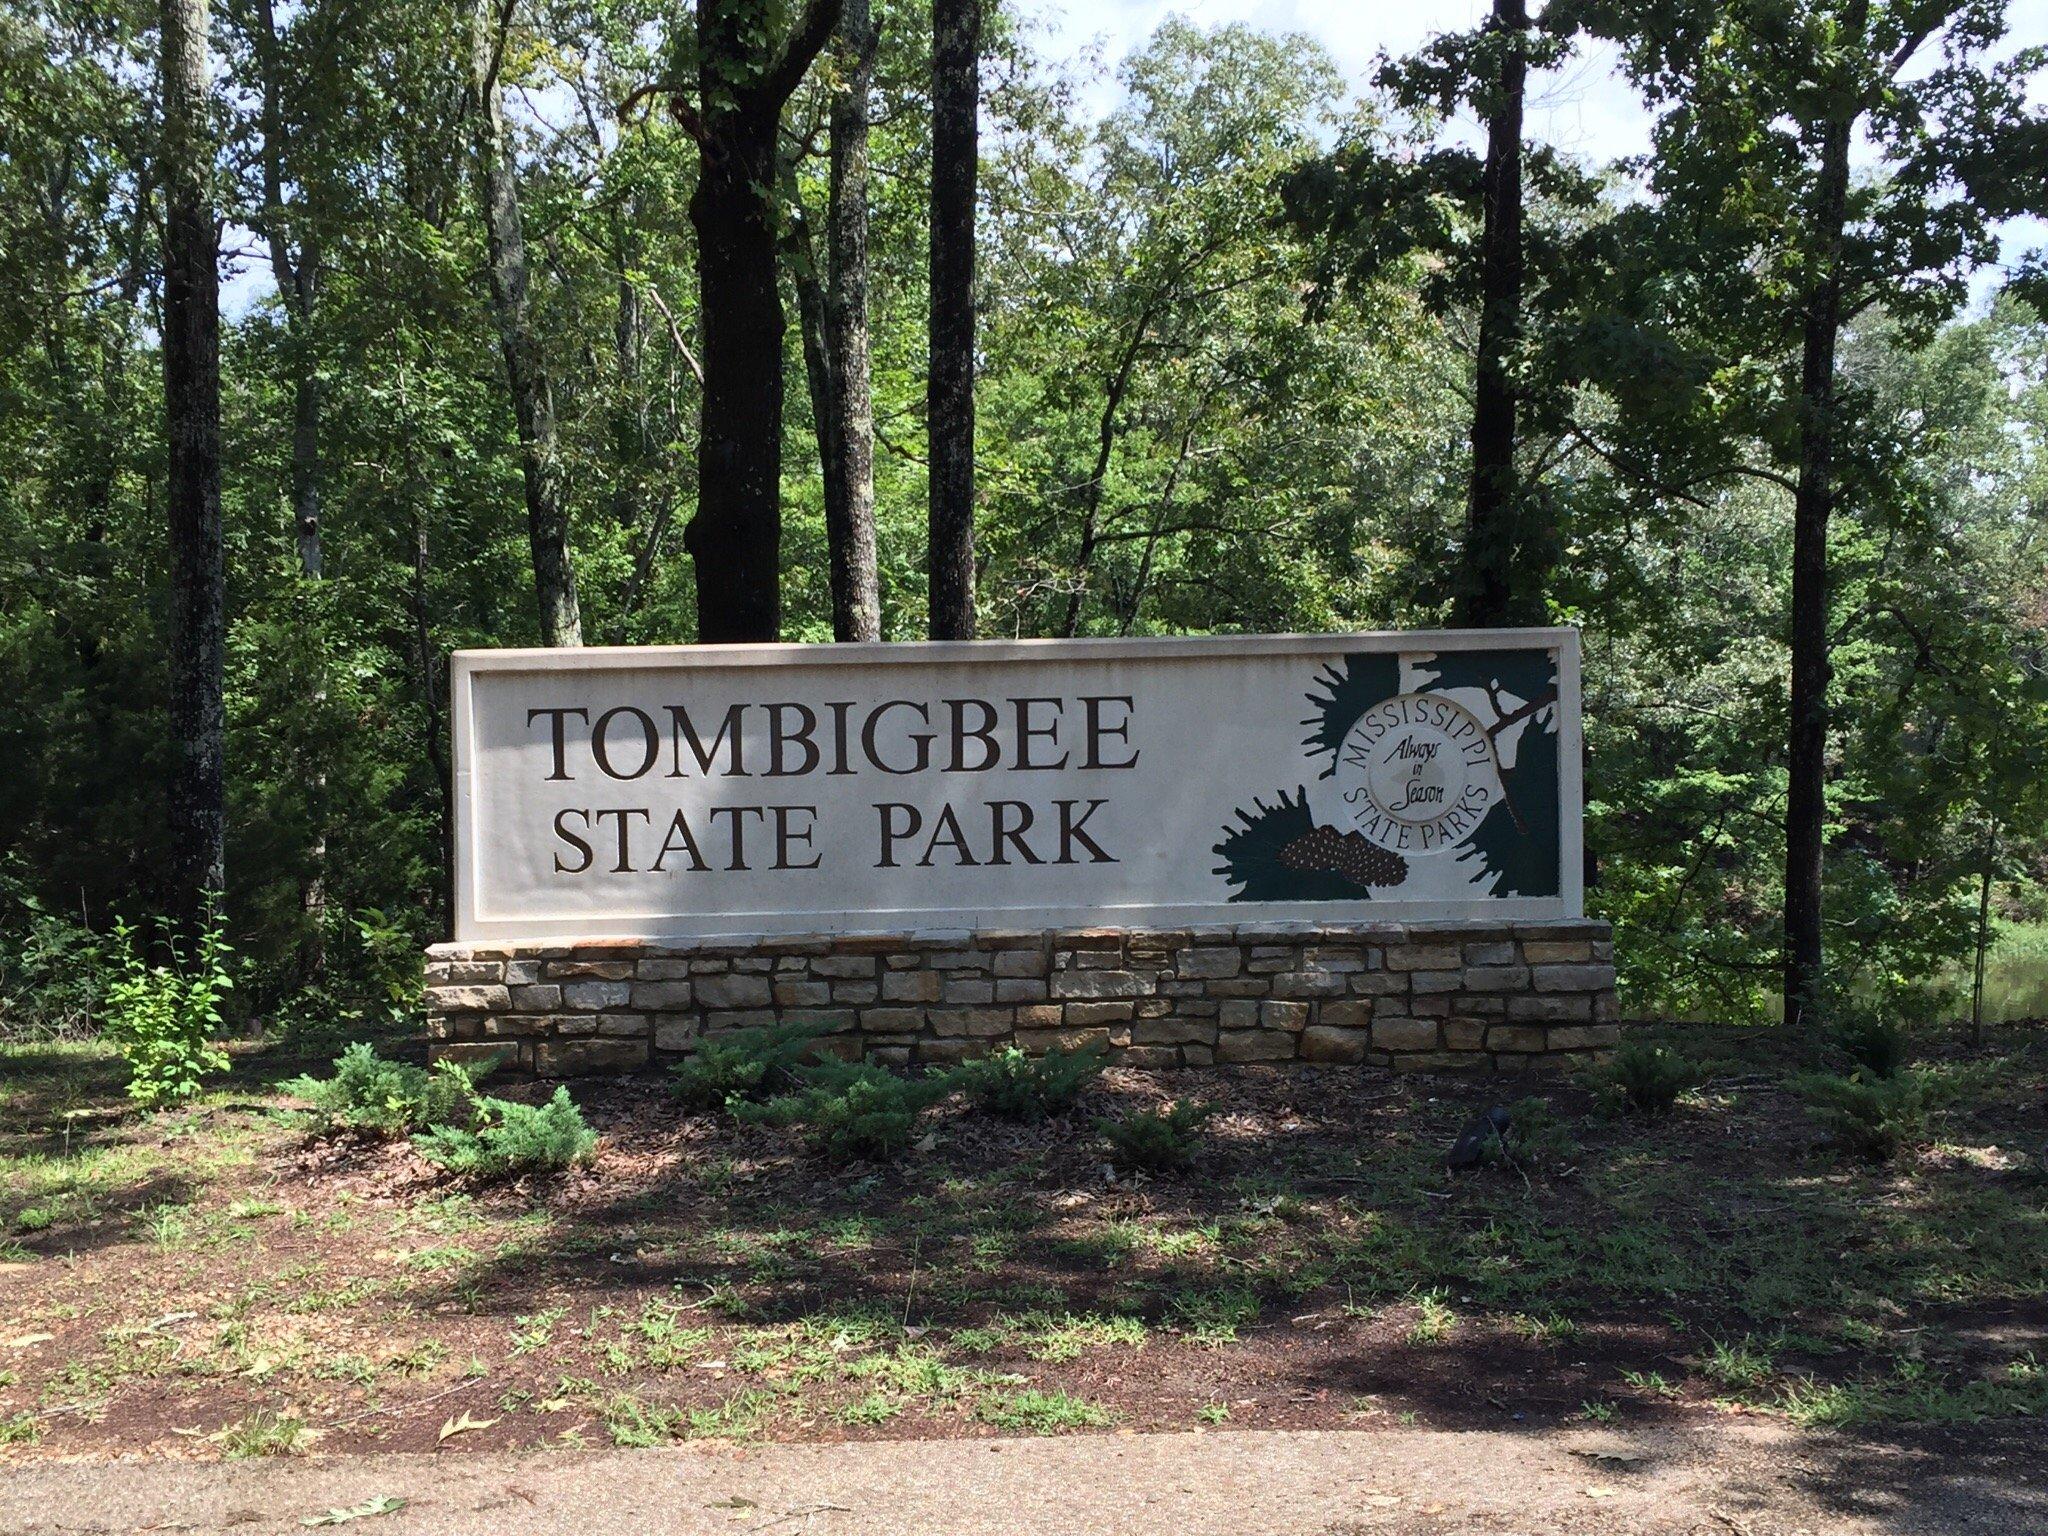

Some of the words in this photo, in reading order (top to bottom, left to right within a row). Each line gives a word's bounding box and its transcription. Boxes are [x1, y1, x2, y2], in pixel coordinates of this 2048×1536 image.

[527, 695, 1140, 781] TOMBIGBEE
[1343, 698, 1490, 769] MISSISSIPPI
[1383, 735, 1442, 764] Always
[1389, 779, 1444, 811] Season
[1413, 761, 1423, 775] in
[553, 805, 823, 874] STATE
[872, 799, 1120, 868] PARK
[1343, 787, 1411, 849] STATE
[1420, 784, 1488, 849] PARKS
